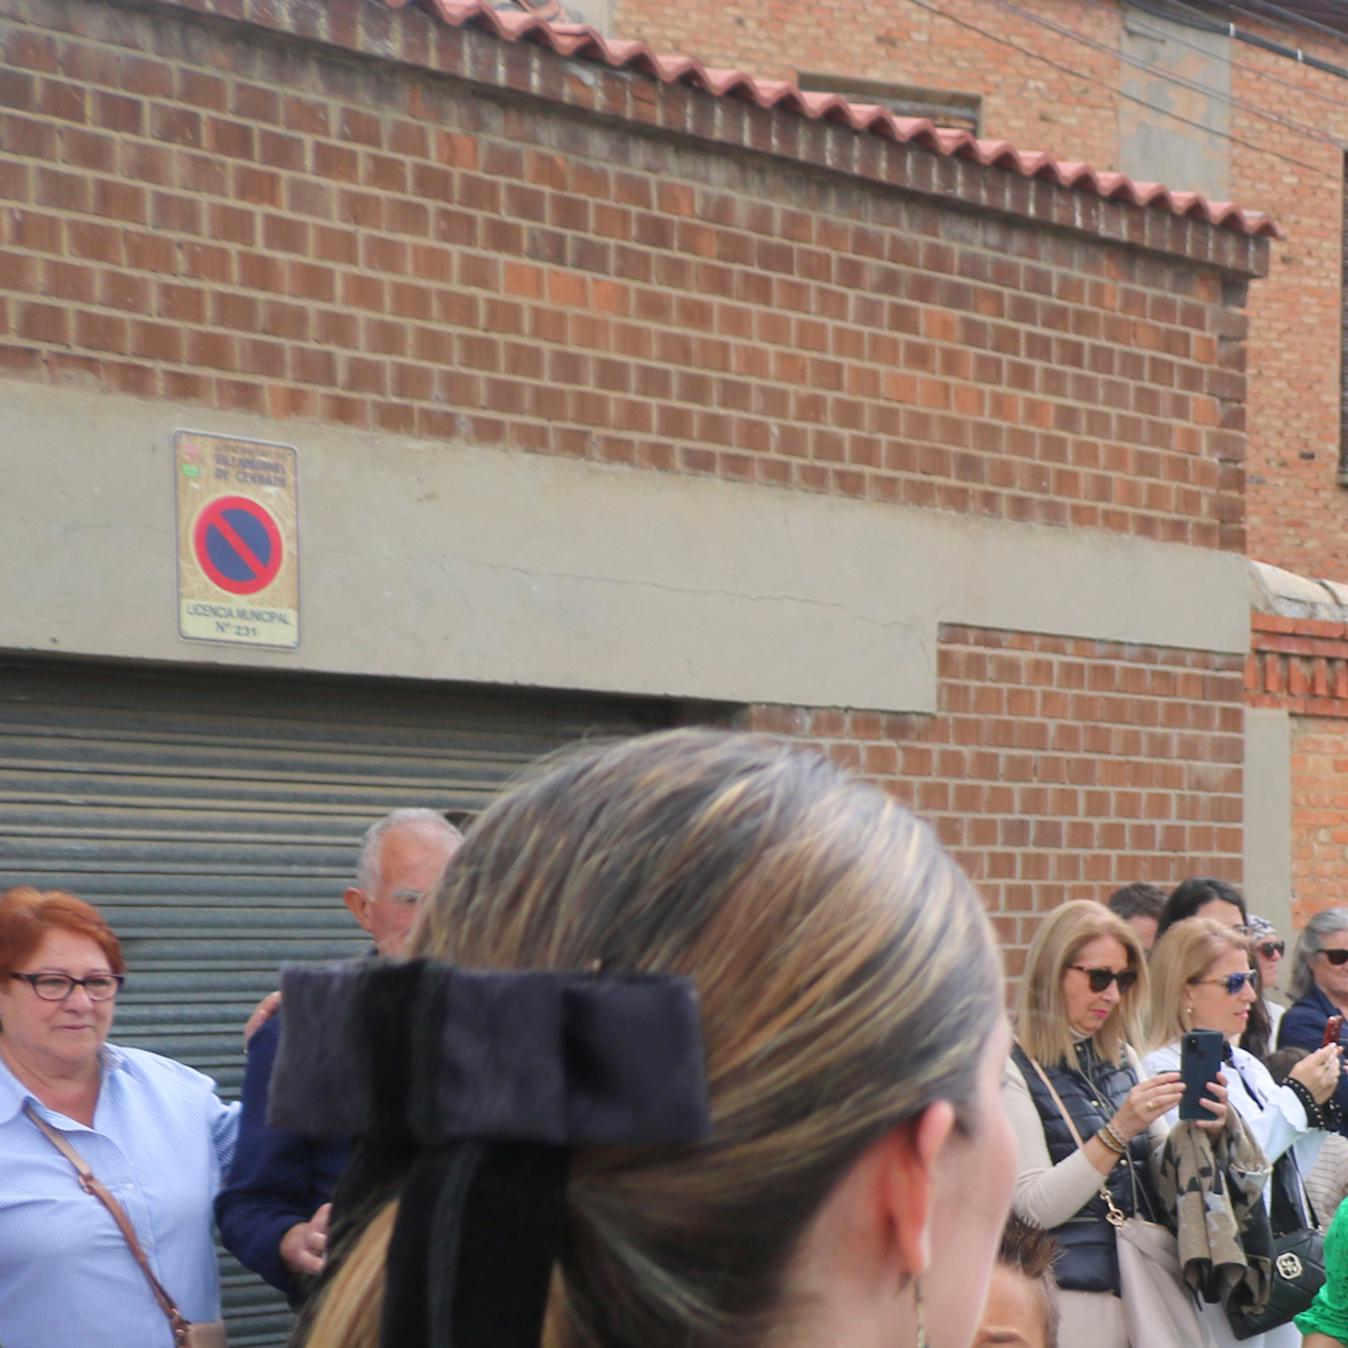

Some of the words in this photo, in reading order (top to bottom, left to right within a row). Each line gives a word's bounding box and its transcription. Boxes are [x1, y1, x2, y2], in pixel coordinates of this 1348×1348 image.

[187, 603, 234, 618] LICENCIA
[237, 608, 290, 624] MUNICIPAL
[235, 625, 257, 636] 231
